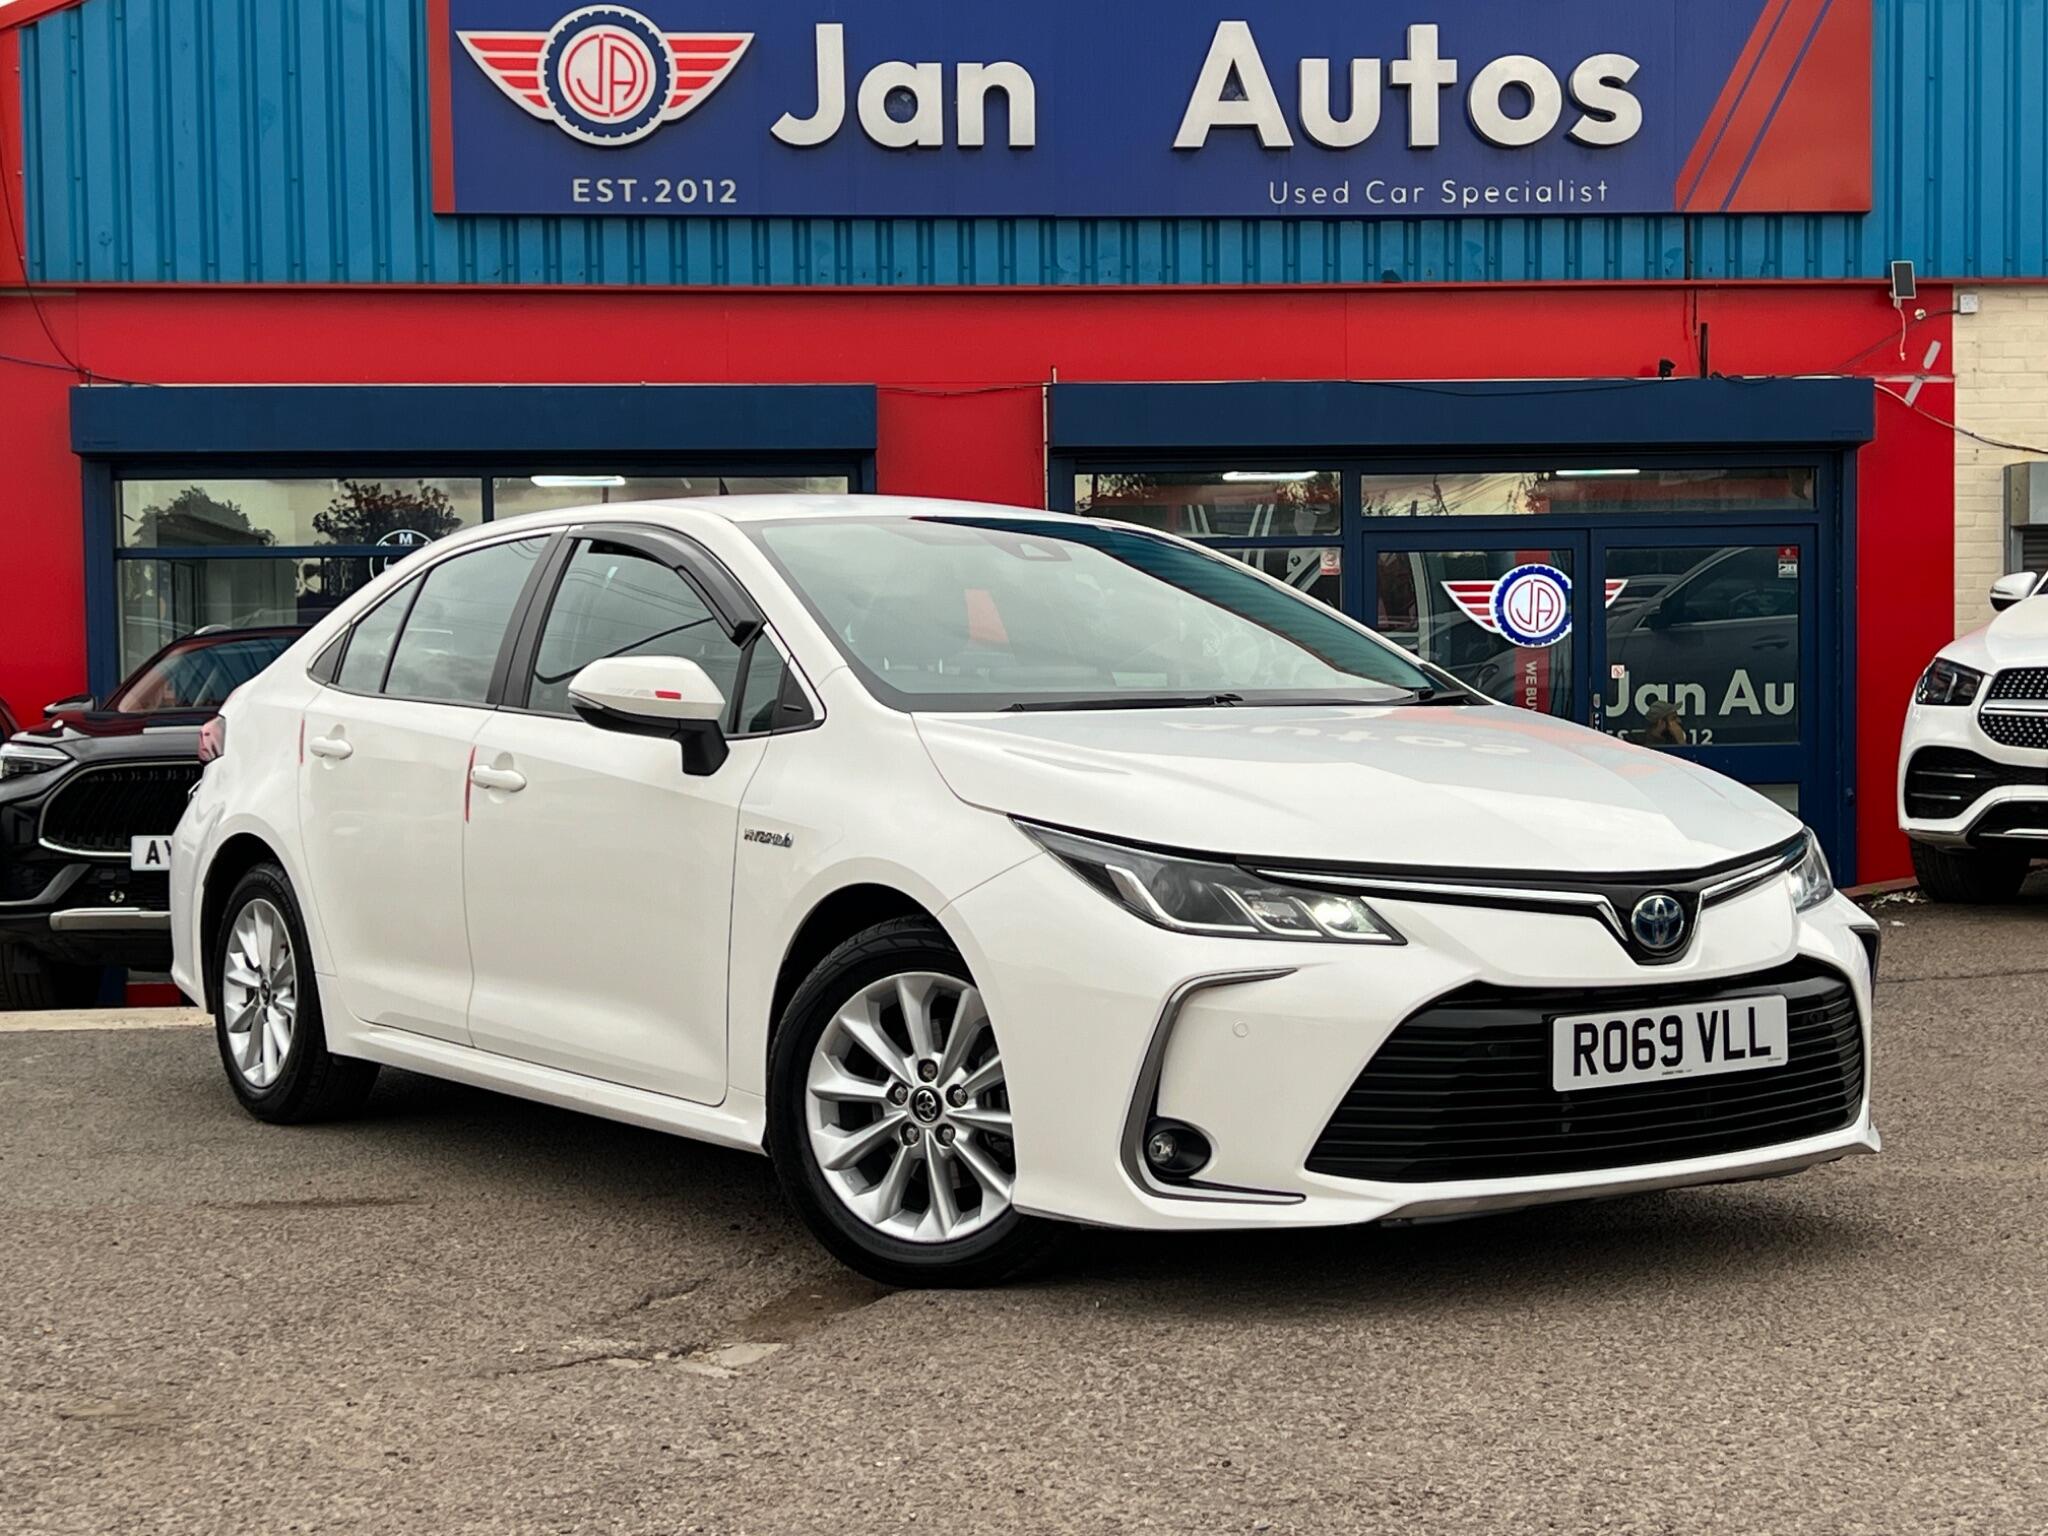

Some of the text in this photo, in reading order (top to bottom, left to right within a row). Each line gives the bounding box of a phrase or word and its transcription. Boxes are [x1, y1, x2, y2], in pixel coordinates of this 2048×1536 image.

[770, 19, 1644, 148] Jan Autos
[571, 178, 738, 204] EST.2012
[1268, 178, 1609, 209] Used Car Specialist
[1525, 660, 1538, 685] WE
[1605, 668, 1795, 718] Jan Au
[1572, 1006, 1772, 1077] RO69 VLL
